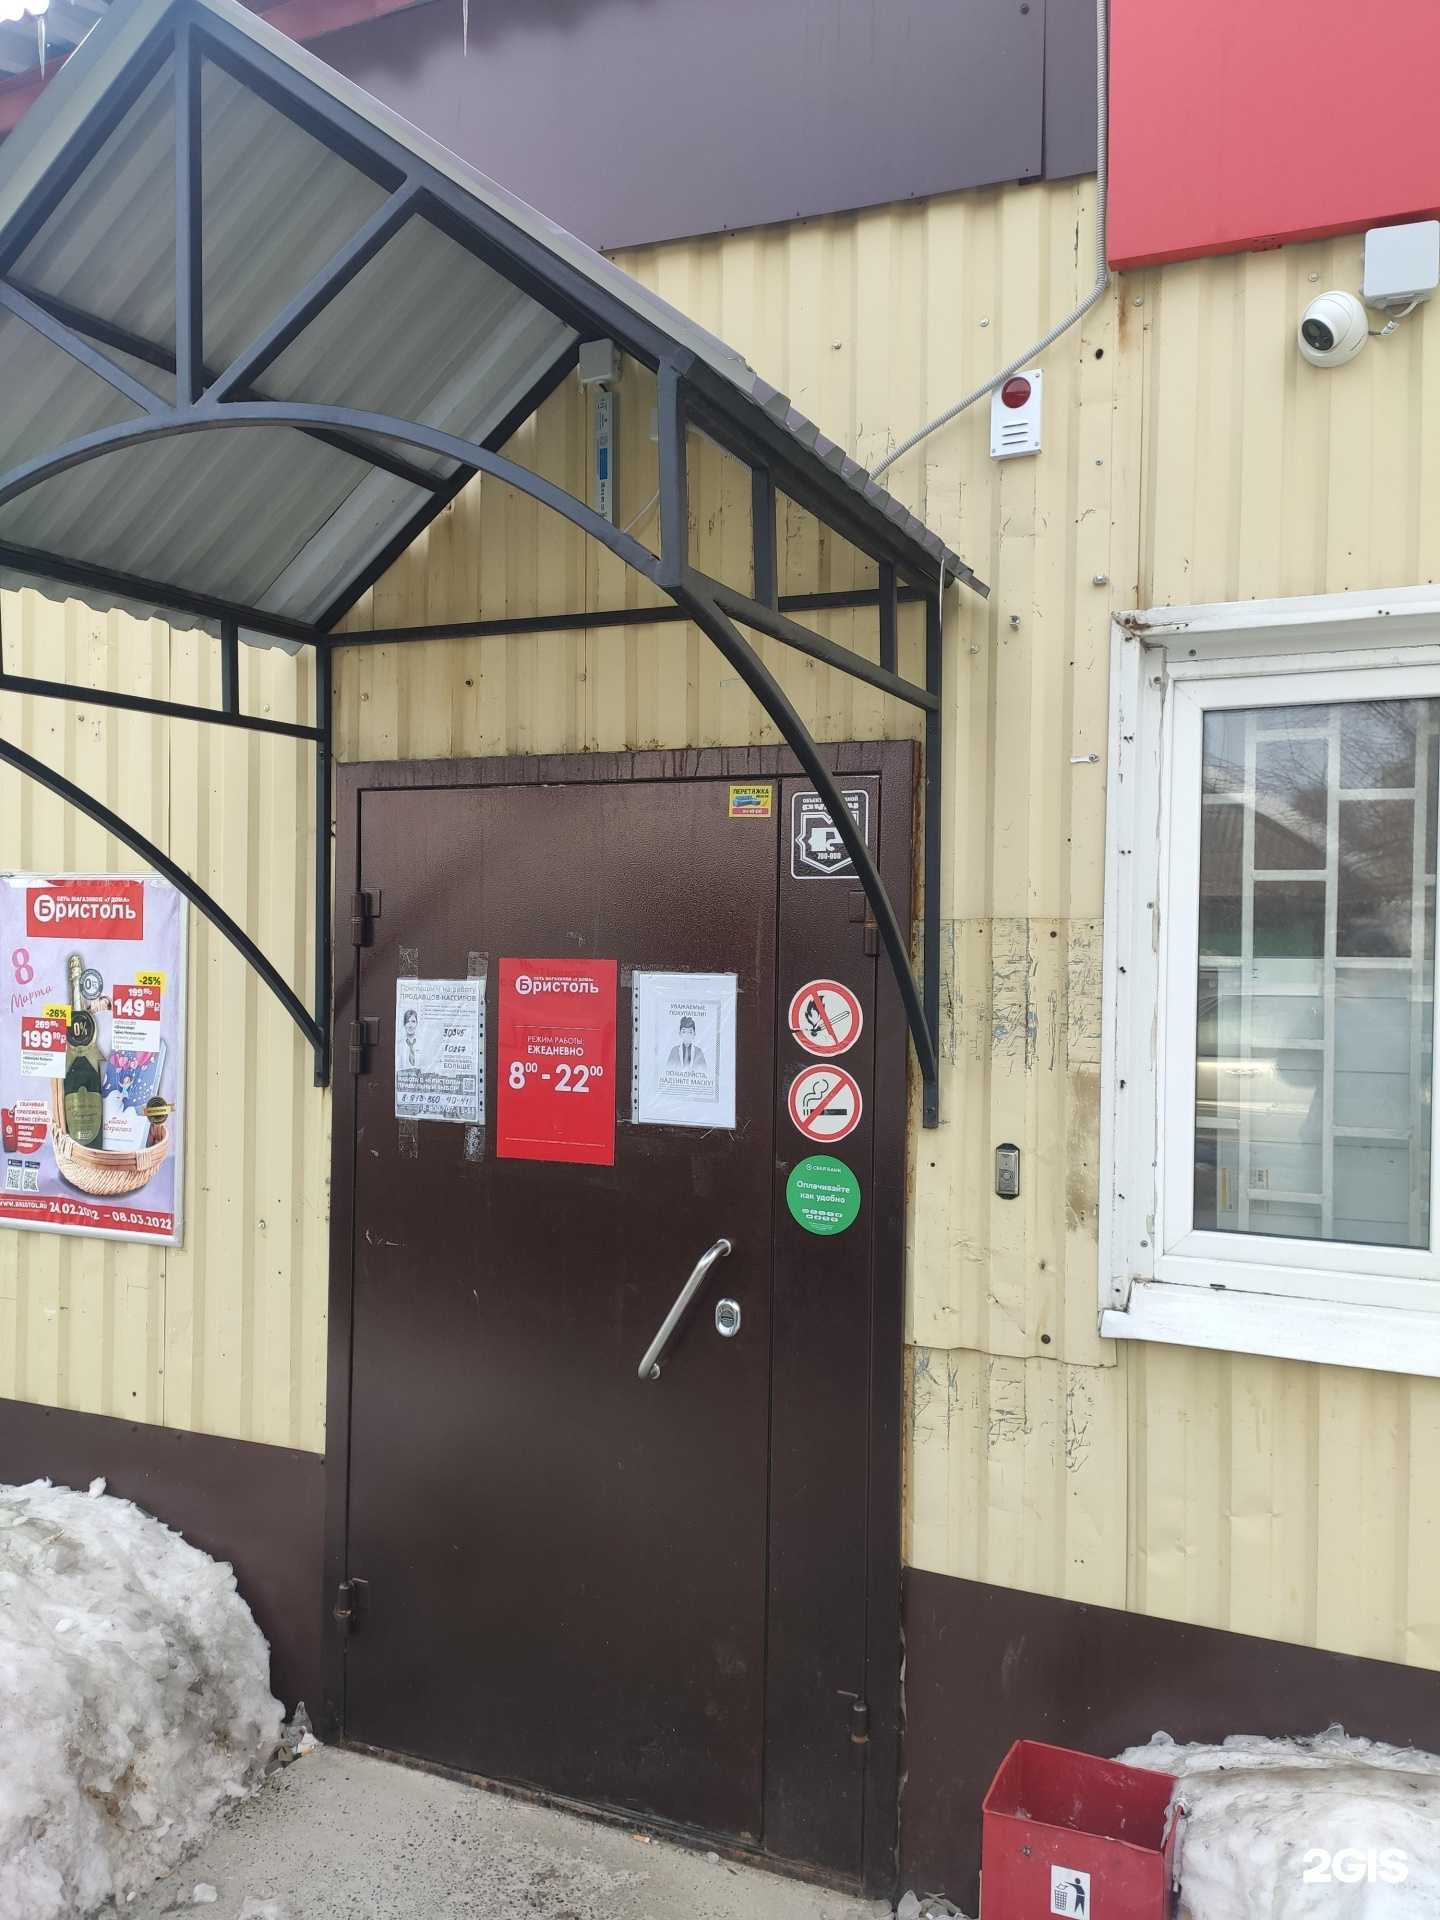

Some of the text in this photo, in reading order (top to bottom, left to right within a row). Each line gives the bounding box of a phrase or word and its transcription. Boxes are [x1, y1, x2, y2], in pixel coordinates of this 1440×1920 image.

[33, 894, 136, 922] Бристоль
[11, 947, 34, 985] 8
[138, 976, 161, 985] -25%
[515, 975, 599, 995] Бристоль
[10, 985, 54, 1013] Марта
[45, 1009, 66, 1018] -26%
[527, 1035, 552, 1043] РЕЖИМ
[527, 1045, 584, 1056] ЕЖЕДНЕВНО
[796, 1180, 850, 1193] Оплачивайте
[816, 1194, 845, 1204] удобно
[112, 1210, 172, 1230] 08.03.2022
